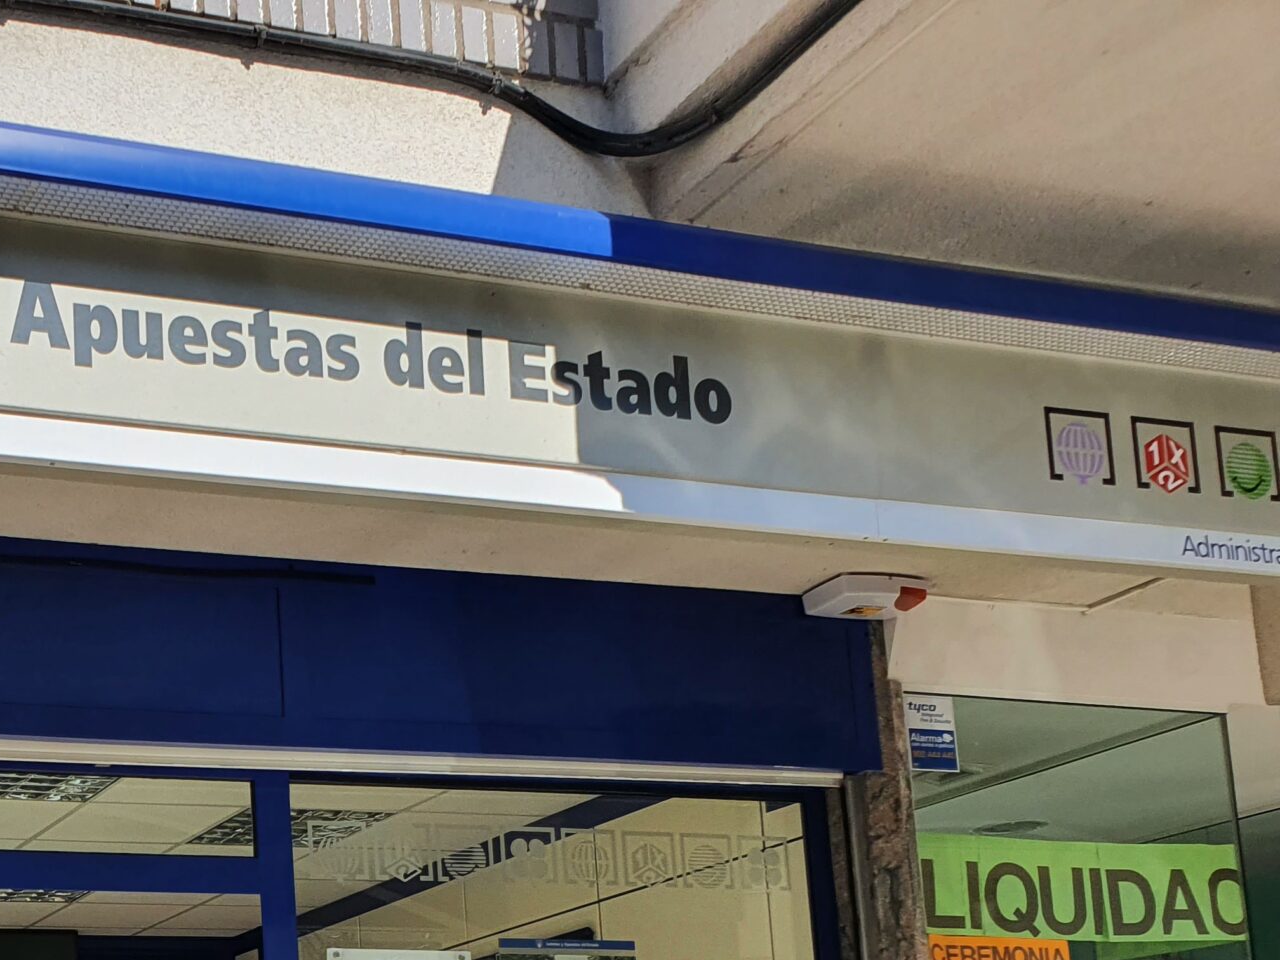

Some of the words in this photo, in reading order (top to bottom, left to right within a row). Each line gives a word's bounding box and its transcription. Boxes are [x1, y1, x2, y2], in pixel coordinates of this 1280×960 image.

[10, 281, 361, 386] Apuestas
[384, 321, 485, 397] del
[509, 340, 733, 425] Estado
[907, 702, 936, 713] tyco
